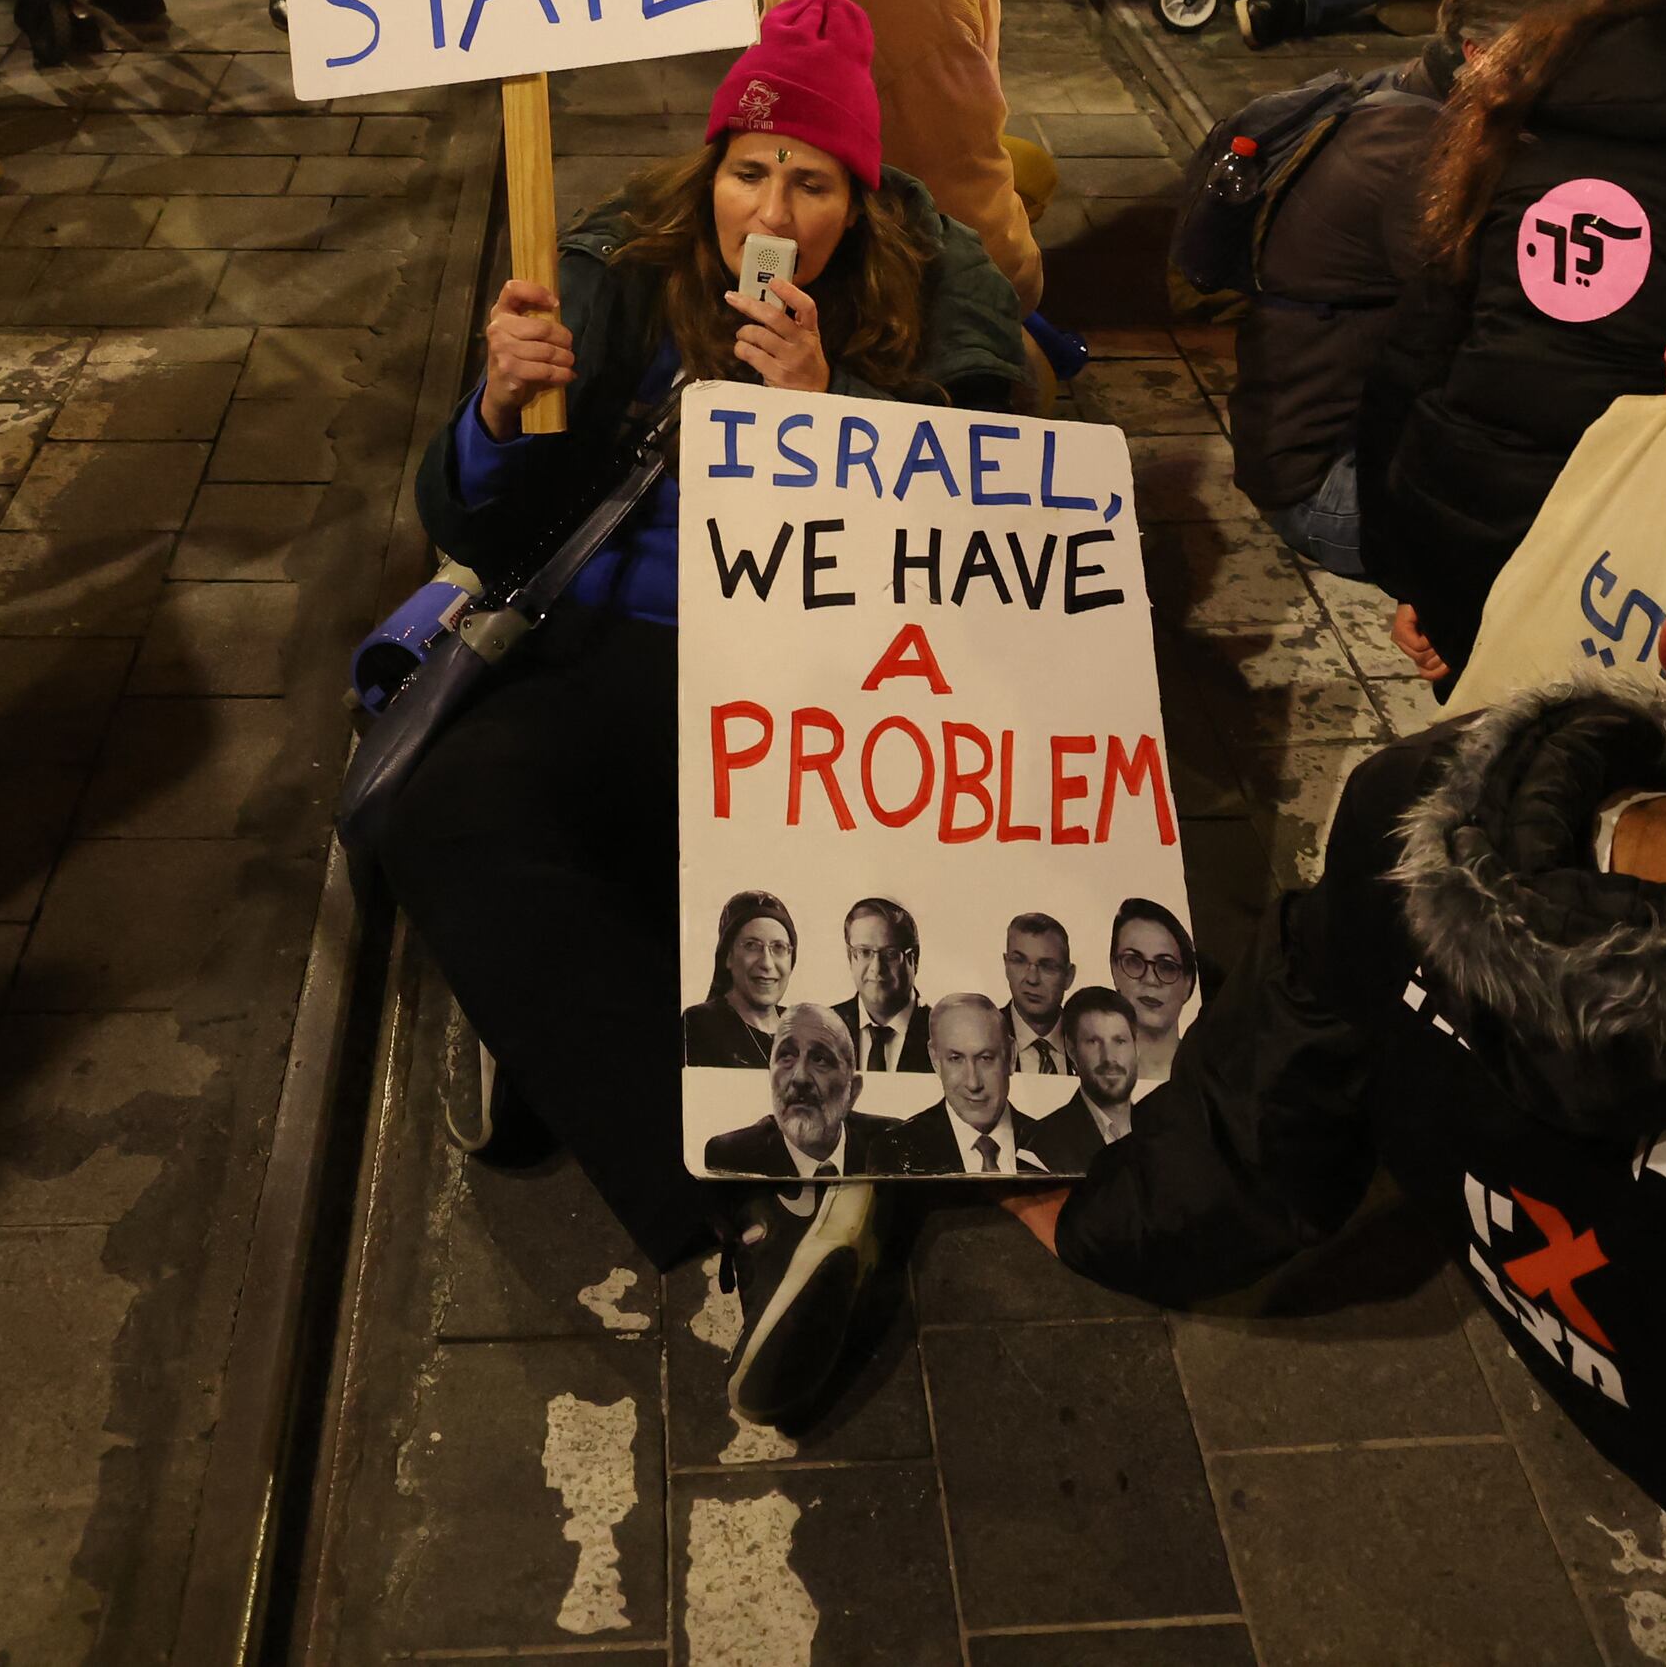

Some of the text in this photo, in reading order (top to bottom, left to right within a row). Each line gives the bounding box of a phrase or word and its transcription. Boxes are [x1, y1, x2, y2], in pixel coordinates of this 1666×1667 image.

[707, 408, 1123, 523] ISRAEL,
[707, 518, 1125, 615] WE HAVE
[861, 623, 952, 695] A
[711, 700, 1177, 845] PROBLEM
